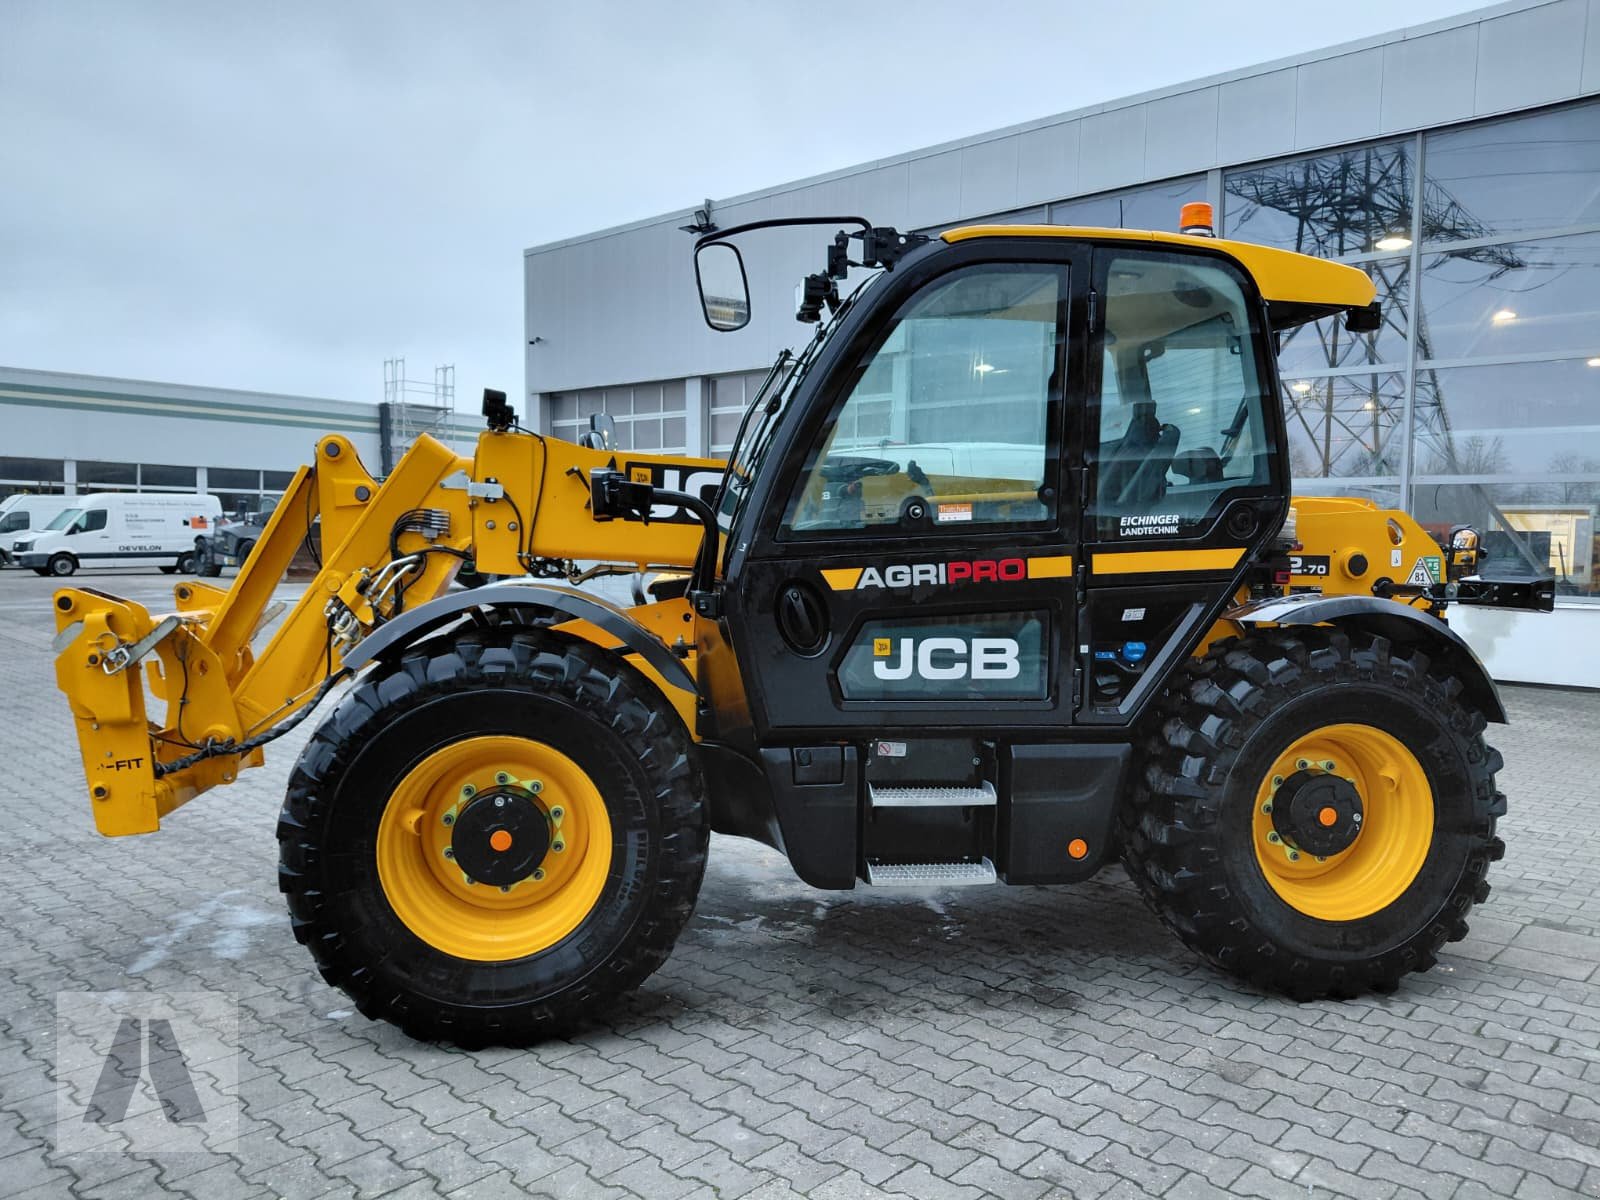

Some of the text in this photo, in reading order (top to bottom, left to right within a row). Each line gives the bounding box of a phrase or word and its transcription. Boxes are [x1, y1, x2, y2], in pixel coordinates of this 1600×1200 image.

[631, 469, 737, 531] JC
[1120, 514, 1179, 526] EICHINGER
[1120, 526, 1179, 537] LANDTECHNIK
[857, 559, 1026, 590] AGRIPRO
[873, 637, 1020, 680] JCB
[97, 758, 144, 772] -FIT
